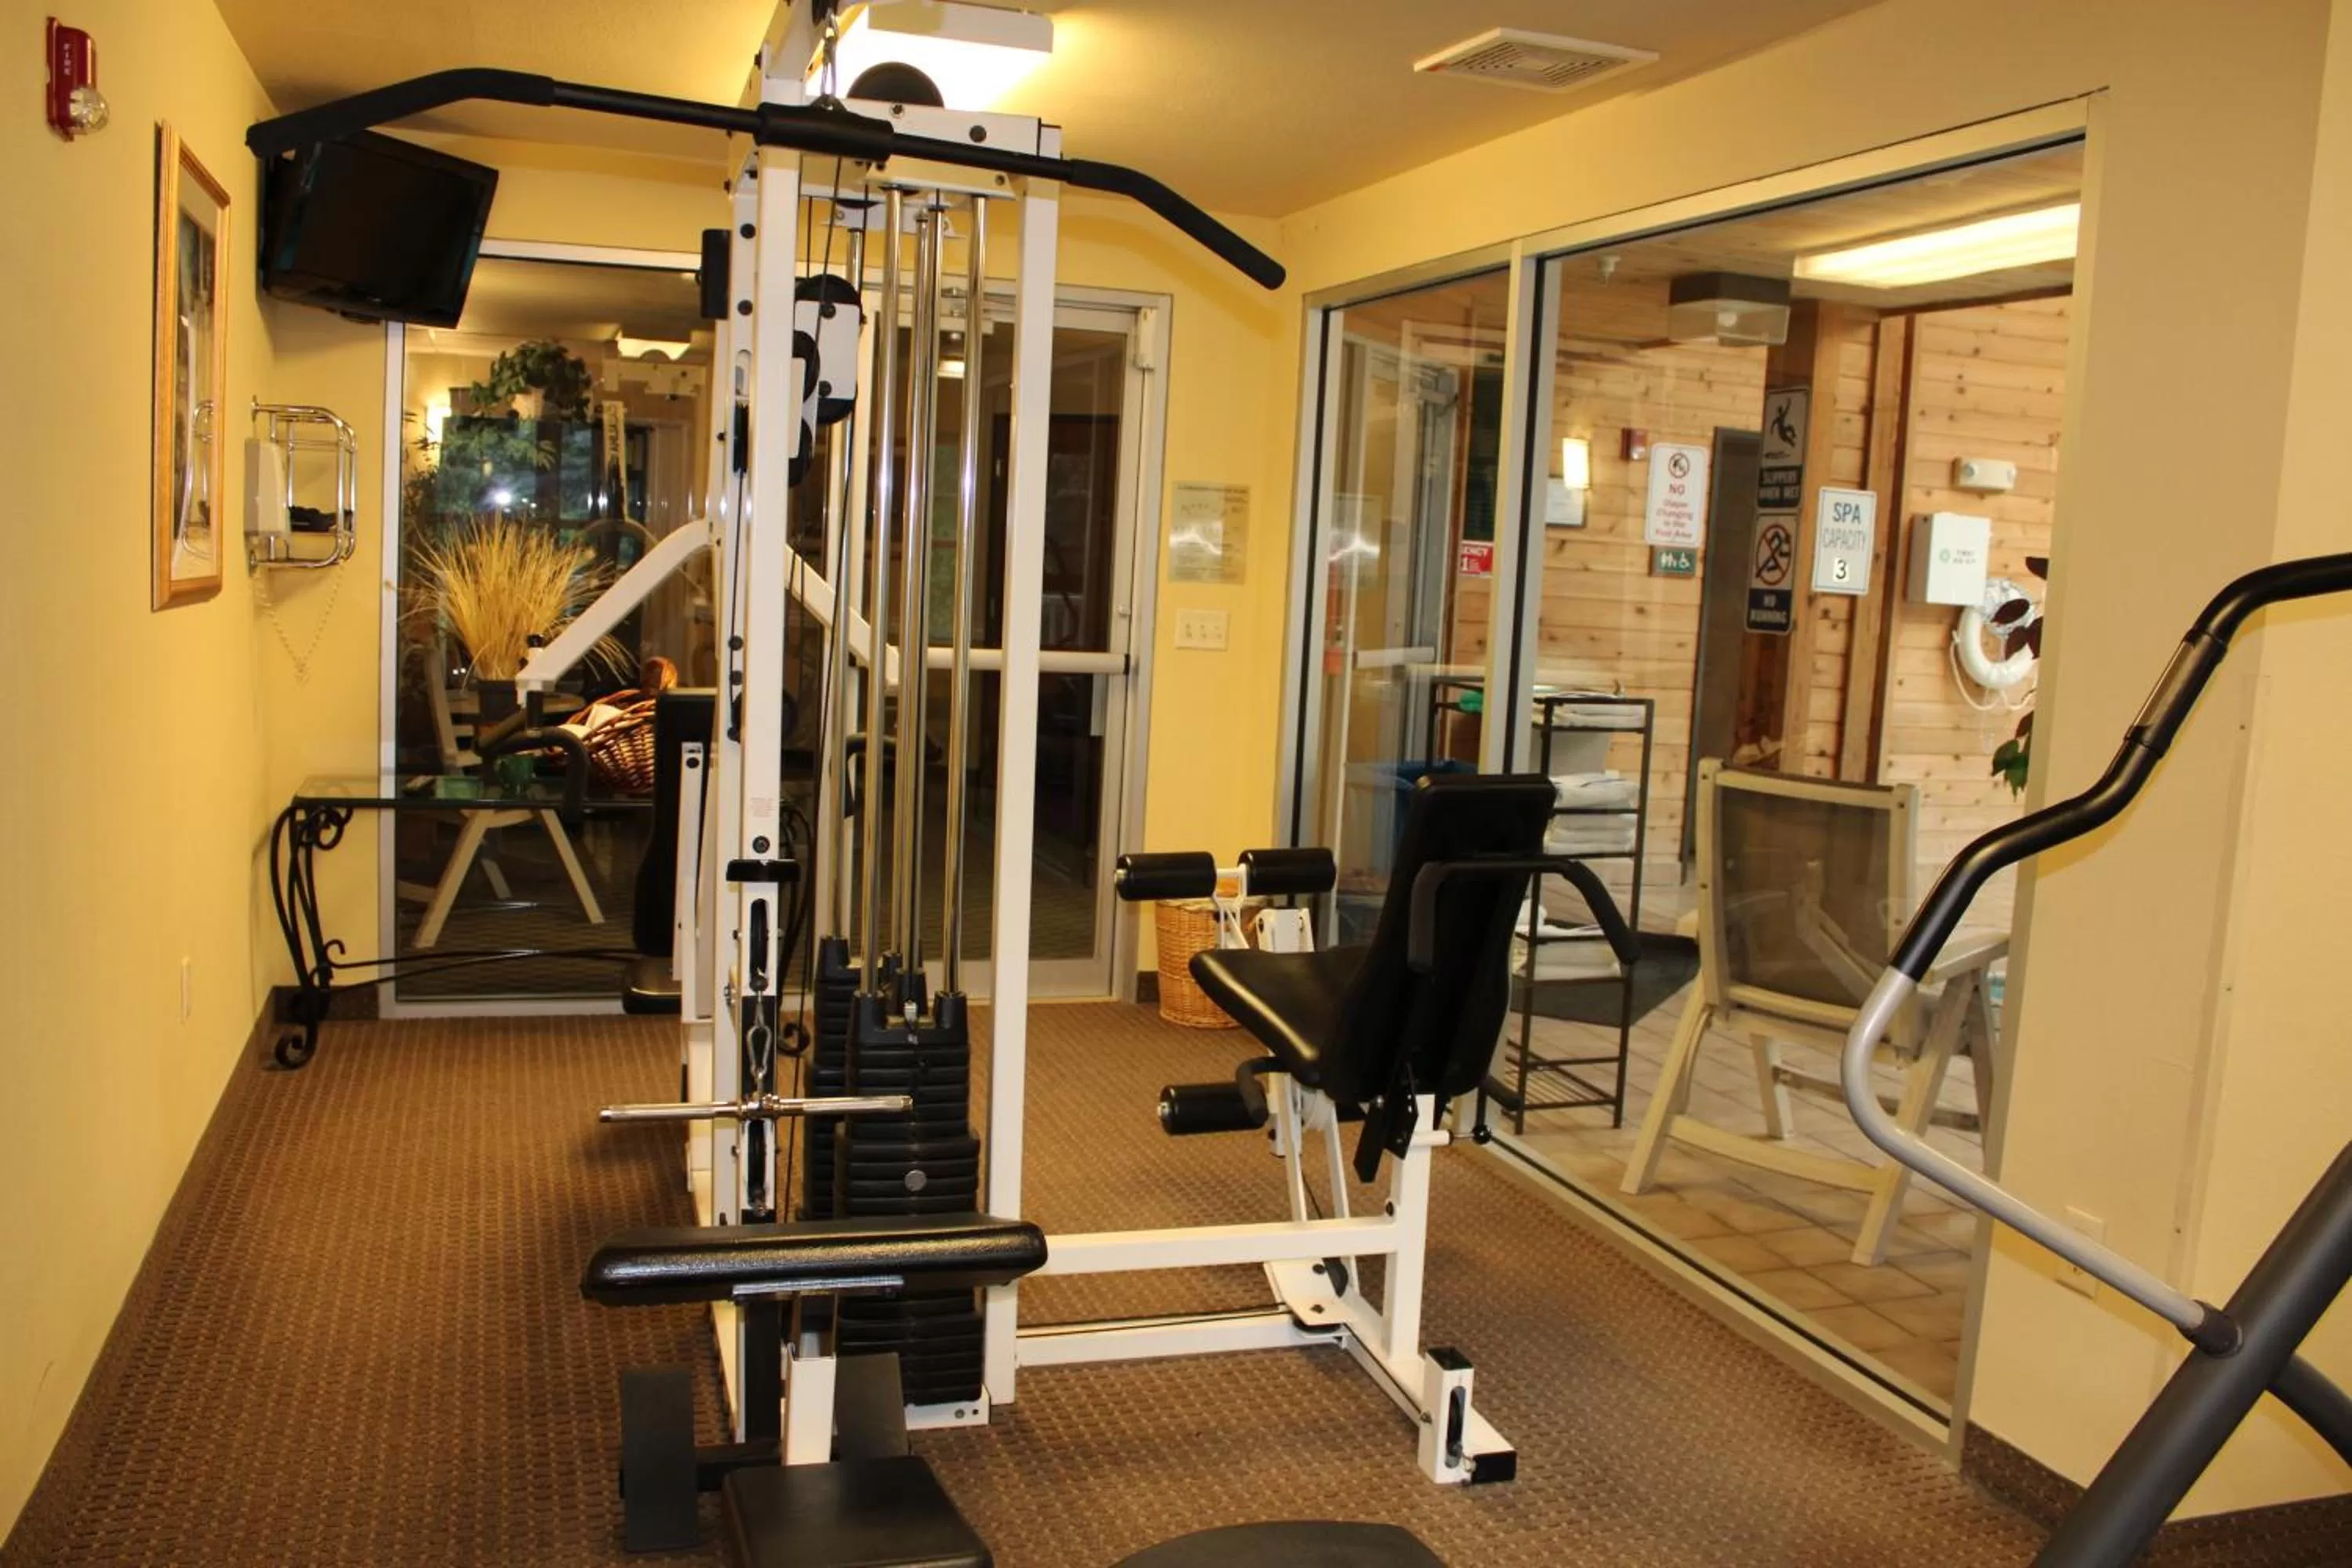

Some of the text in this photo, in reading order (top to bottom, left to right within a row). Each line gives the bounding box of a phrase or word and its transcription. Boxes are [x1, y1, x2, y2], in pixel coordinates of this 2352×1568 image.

[1669, 483, 1686, 495] NO
[1832, 501, 1861, 524] SPA
[1822, 527, 1866, 552] CAPACITY
[1835, 559, 1847, 579] 3
[1763, 594, 1776, 608] NO
